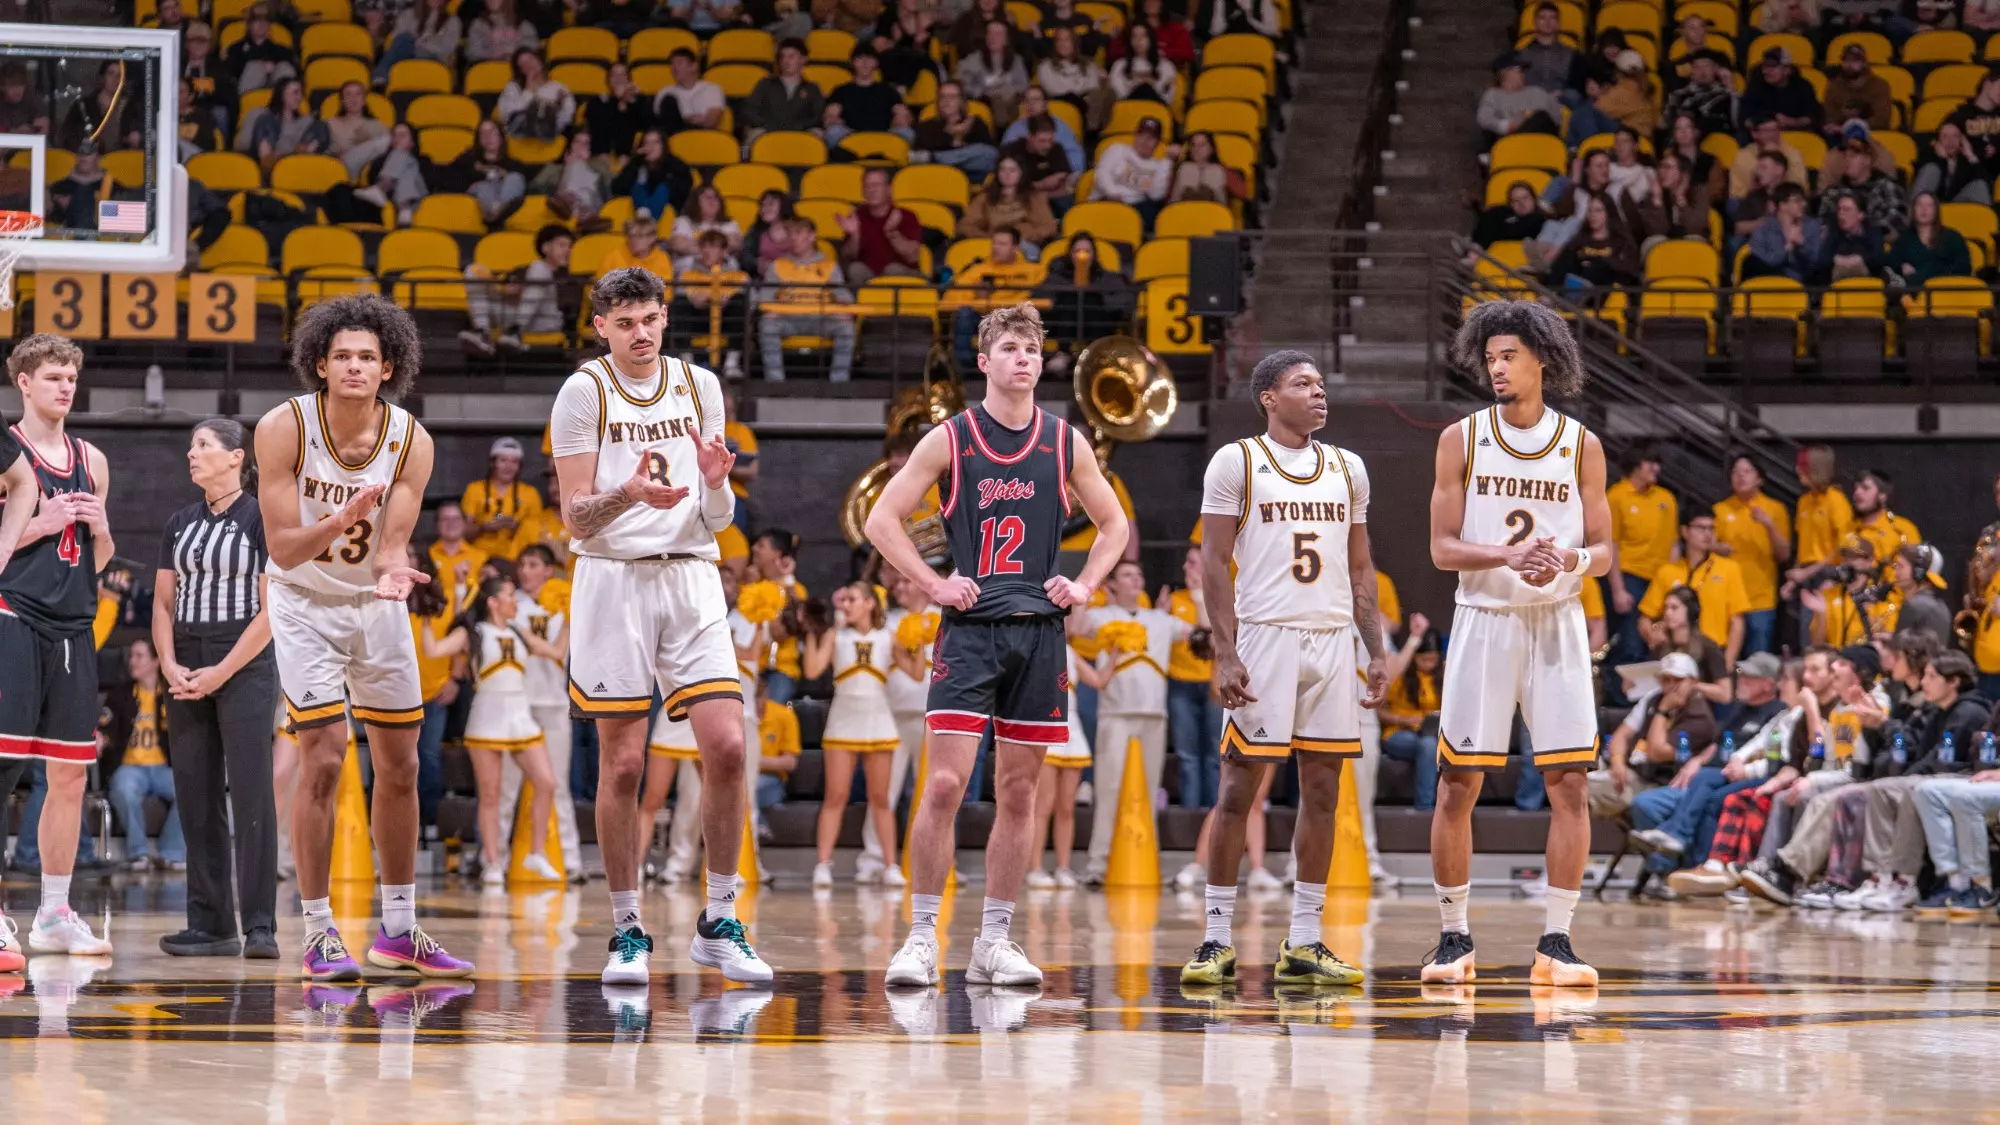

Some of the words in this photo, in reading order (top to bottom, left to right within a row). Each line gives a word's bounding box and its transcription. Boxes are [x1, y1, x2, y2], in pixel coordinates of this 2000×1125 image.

[52, 276, 83, 331] 3
[127, 277, 158, 331] 3
[206, 281, 237, 334] 3
[1165, 293, 1194, 344] 3
[608, 416, 694, 444] WYOMING
[977, 477, 1035, 510] Yotes
[1258, 501, 1346, 524] WYOMING
[1476, 475, 1571, 503] WYOMING
[57, 521, 81, 567] 4
[977, 515, 1026, 579] 12
[1504, 508, 1536, 547] 2
[1291, 530, 1323, 585] 5
